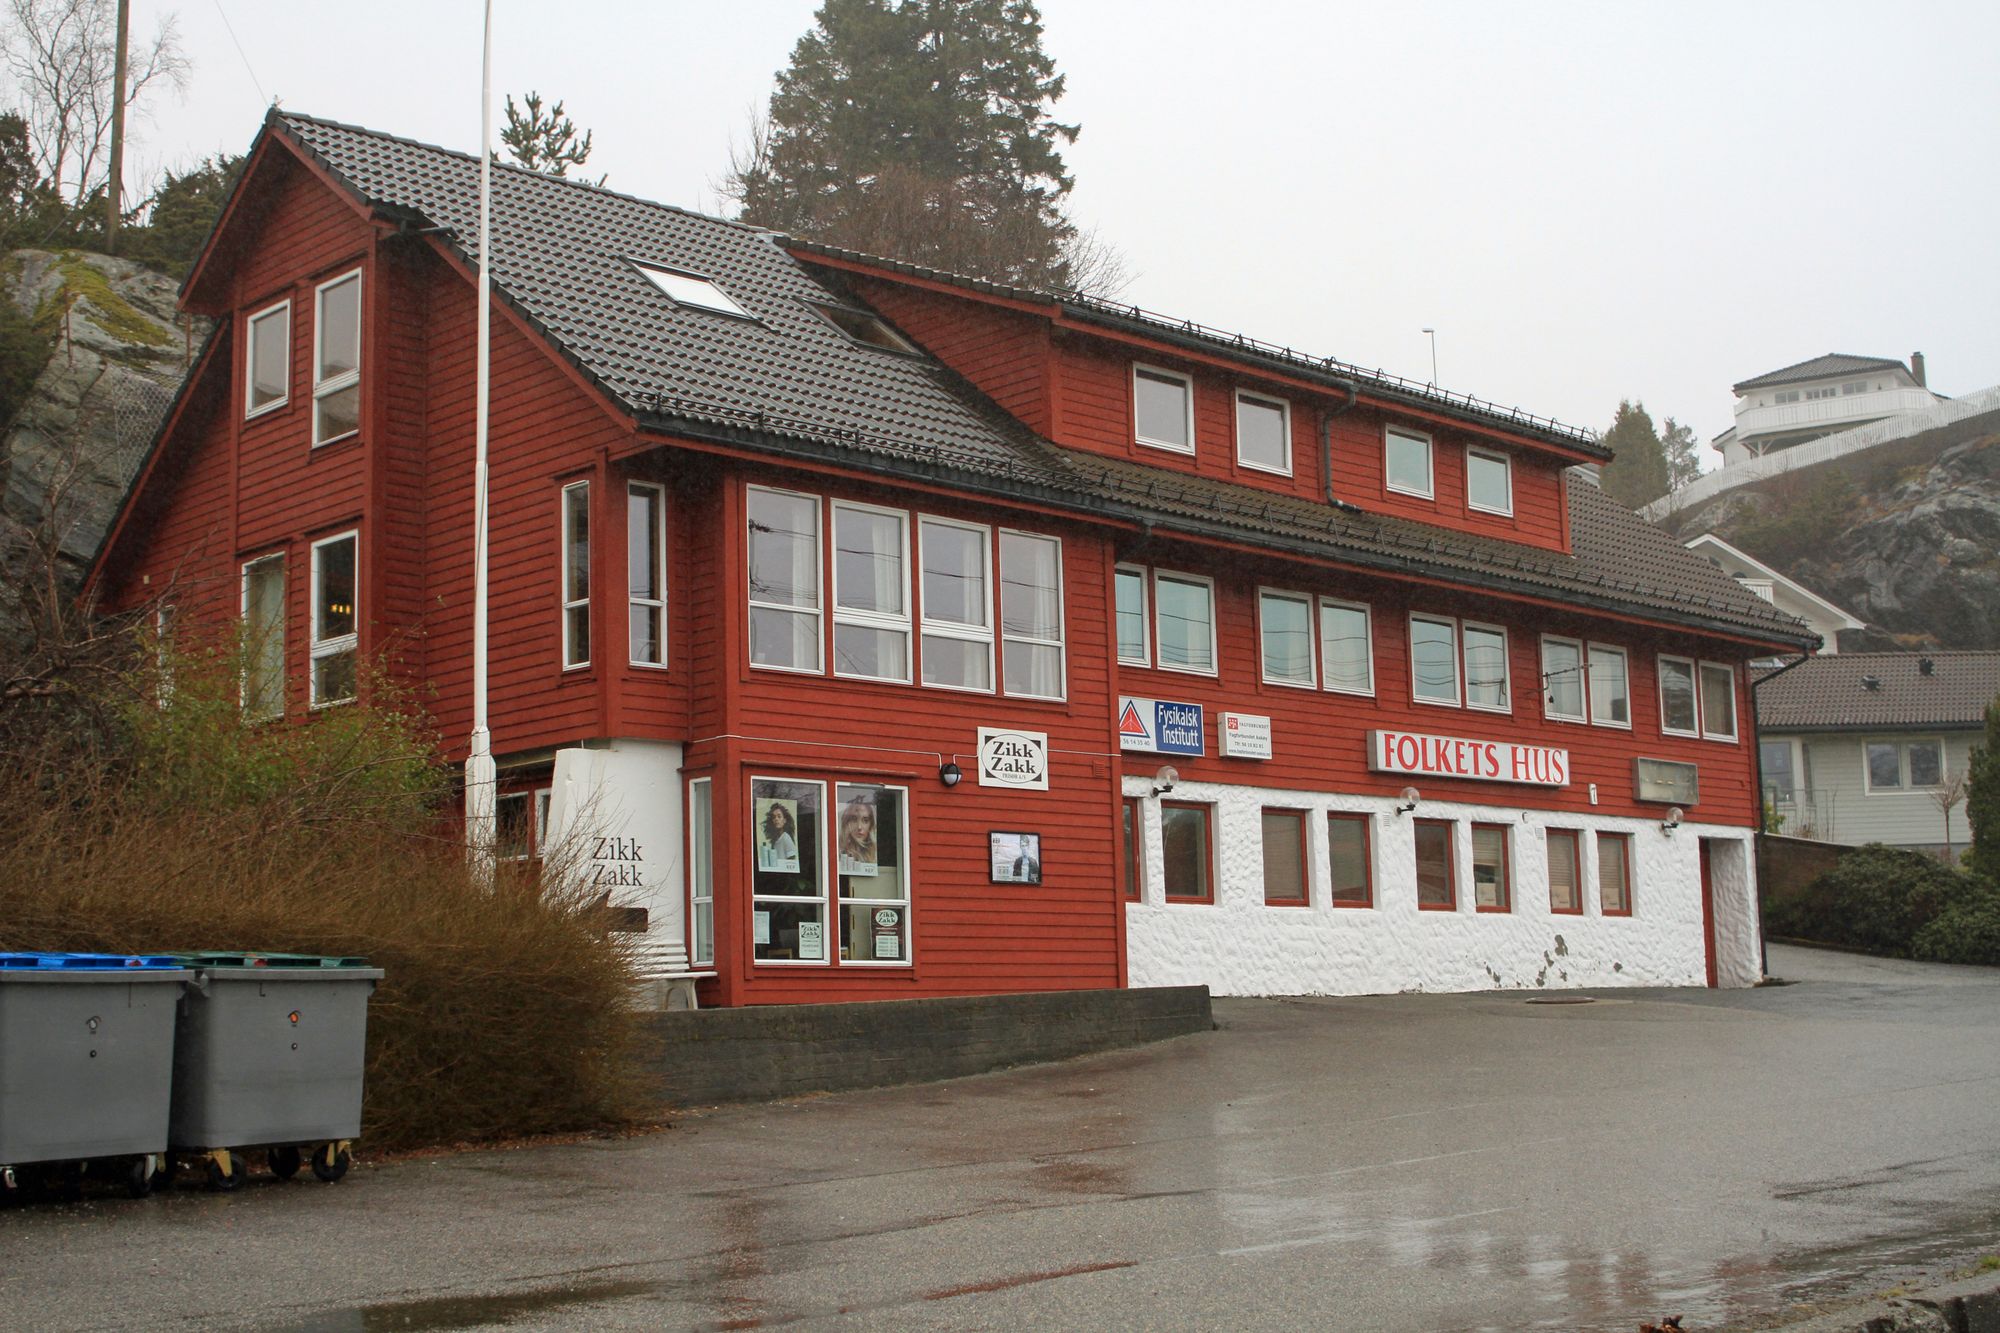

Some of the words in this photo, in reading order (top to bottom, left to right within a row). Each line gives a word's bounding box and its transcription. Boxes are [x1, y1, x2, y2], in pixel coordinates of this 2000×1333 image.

[1158, 704, 1198, 728] Fysikalsk
[1163, 725, 1199, 747] Institutt
[993, 741, 1033, 758] Zikk
[1384, 733, 1500, 777] FOLKETS
[1511, 746, 1564, 783] HUS
[991, 757, 1036, 774] Zakk
[592, 837, 643, 861] Zikk
[592, 864, 643, 886] Zakk
